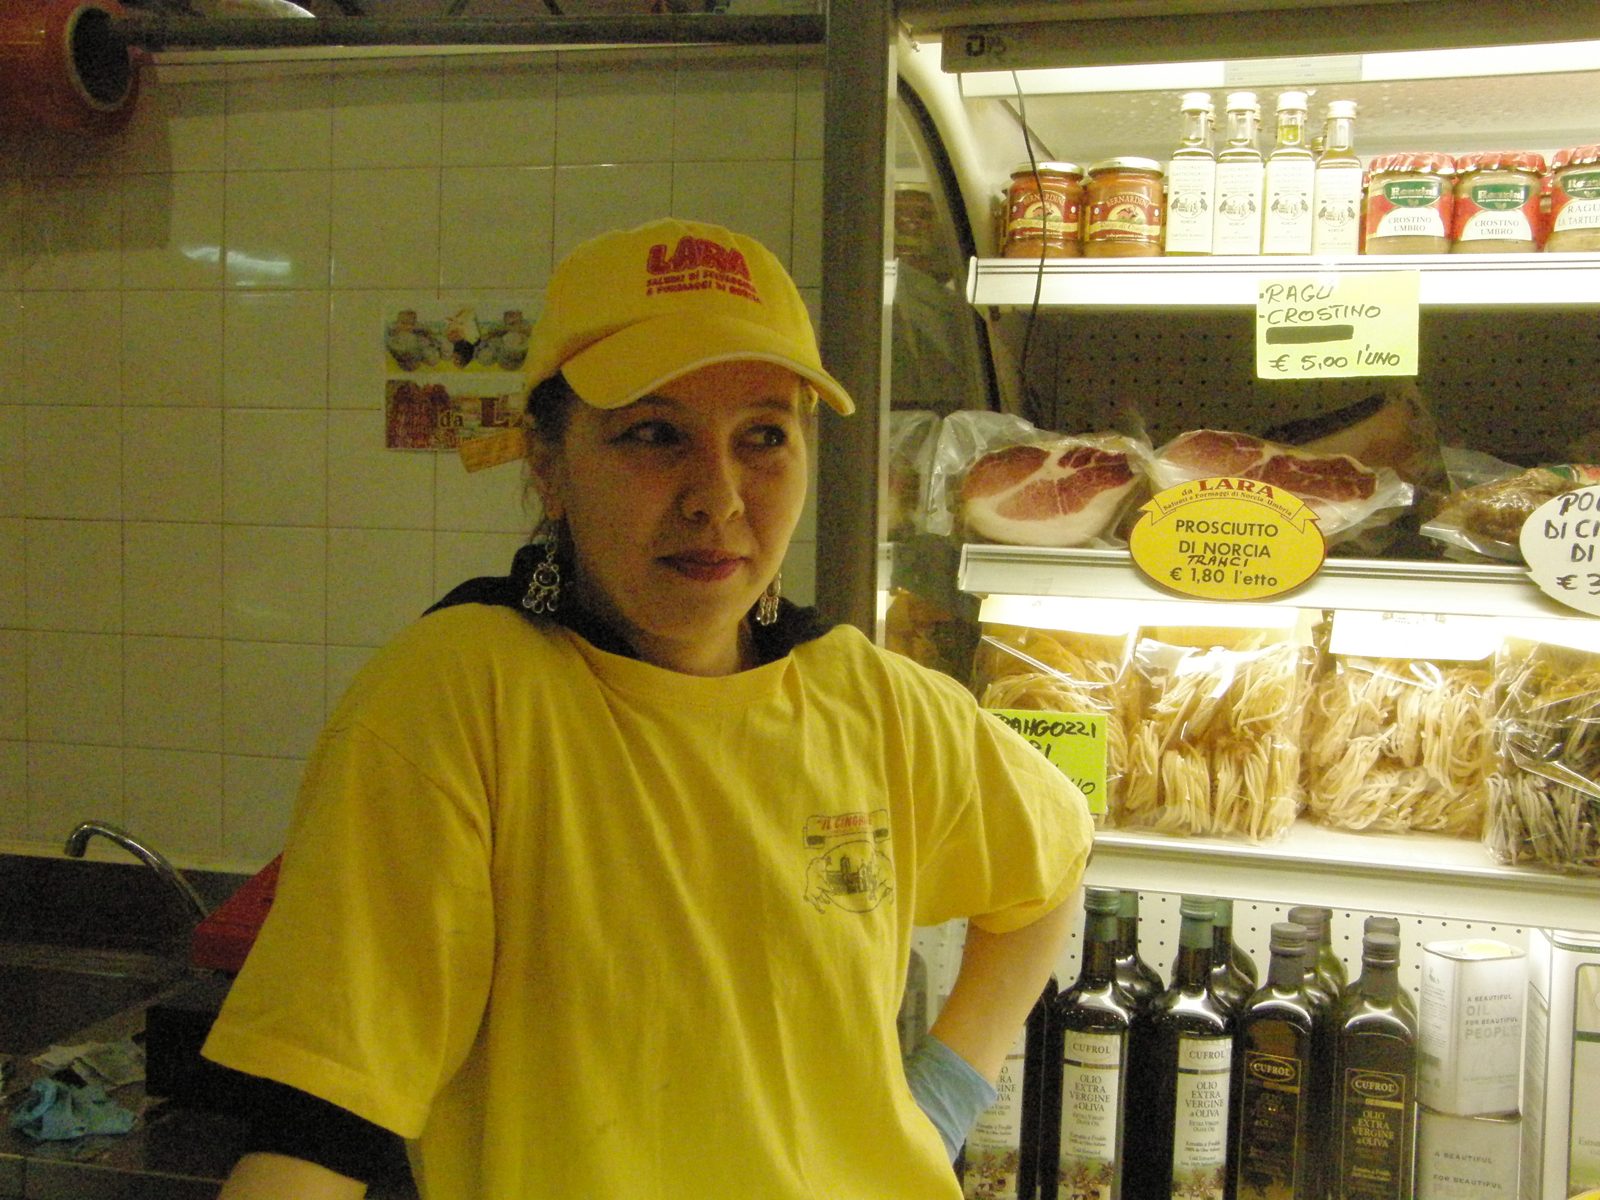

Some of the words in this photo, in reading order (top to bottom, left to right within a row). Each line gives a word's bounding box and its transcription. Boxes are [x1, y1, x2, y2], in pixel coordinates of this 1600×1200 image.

[1105, 193, 1150, 209] BERNARDINI
[1388, 215, 1433, 226] CROSTINO
[1474, 218, 1520, 229] CROSTINO
[1393, 223, 1427, 234] UMBRO
[1480, 227, 1514, 237] UMBRO
[646, 235, 751, 282] LARA
[1267, 303, 1382, 325] CROSTINO
[1268, 353, 1290, 372] €
[1300, 354, 1348, 371] 5,00
[1180, 487, 1194, 497] da
[1197, 477, 1275, 499] LARA
[1194, 490, 1231, 500] Formaggi
[1231, 490, 1239, 498] di
[1240, 491, 1264, 502] Norcia
[1266, 497, 1293, 516] Umbria
[1175, 519, 1279, 538] PROSCIUTTO
[1544, 519, 1568, 540] DI
[1178, 540, 1196, 554] DI
[1202, 542, 1272, 559] NORCIA
[1570, 542, 1595, 563] DI
[1168, 567, 1183, 582] €
[1190, 568, 1226, 585] 1,80
[1233, 570, 1279, 588] l'etto
[1555, 573, 1579, 591] €
[1474, 993, 1513, 1002] BEAUTIFUL
[1466, 1005, 1490, 1017] OIL
[1481, 1016, 1519, 1026] BEAUTIFUL
[1465, 1025, 1521, 1040] PEOPLE
[1072, 1042, 1111, 1055] CUFROL
[1188, 1050, 1225, 1060] CUFROL
[1253, 1062, 1291, 1077] CUFROL
[1079, 1074, 1103, 1084] OLIO
[1196, 1080, 1218, 1090] OLIO
[1074, 1082, 1107, 1094] EXTRA
[1354, 1079, 1395, 1093] CUFROL
[1068, 1090, 1111, 1103] VERGINE
[1191, 1090, 1221, 1099] EXTRA
[1078, 1101, 1105, 1112] OLIVA
[1185, 1099, 1225, 1109] VERGINE
[1195, 1109, 1220, 1118] OLIVA
[1362, 1110, 1385, 1120] OLIO
[1357, 1118, 1390, 1130] EXTRA
[1351, 1126, 1395, 1140] VERGINE
[1443, 1152, 1493, 1164] BEAUTIFUL
[1433, 1174, 1450, 1182] FOR
[1453, 1176, 1503, 1190] BEAUTIFUL
